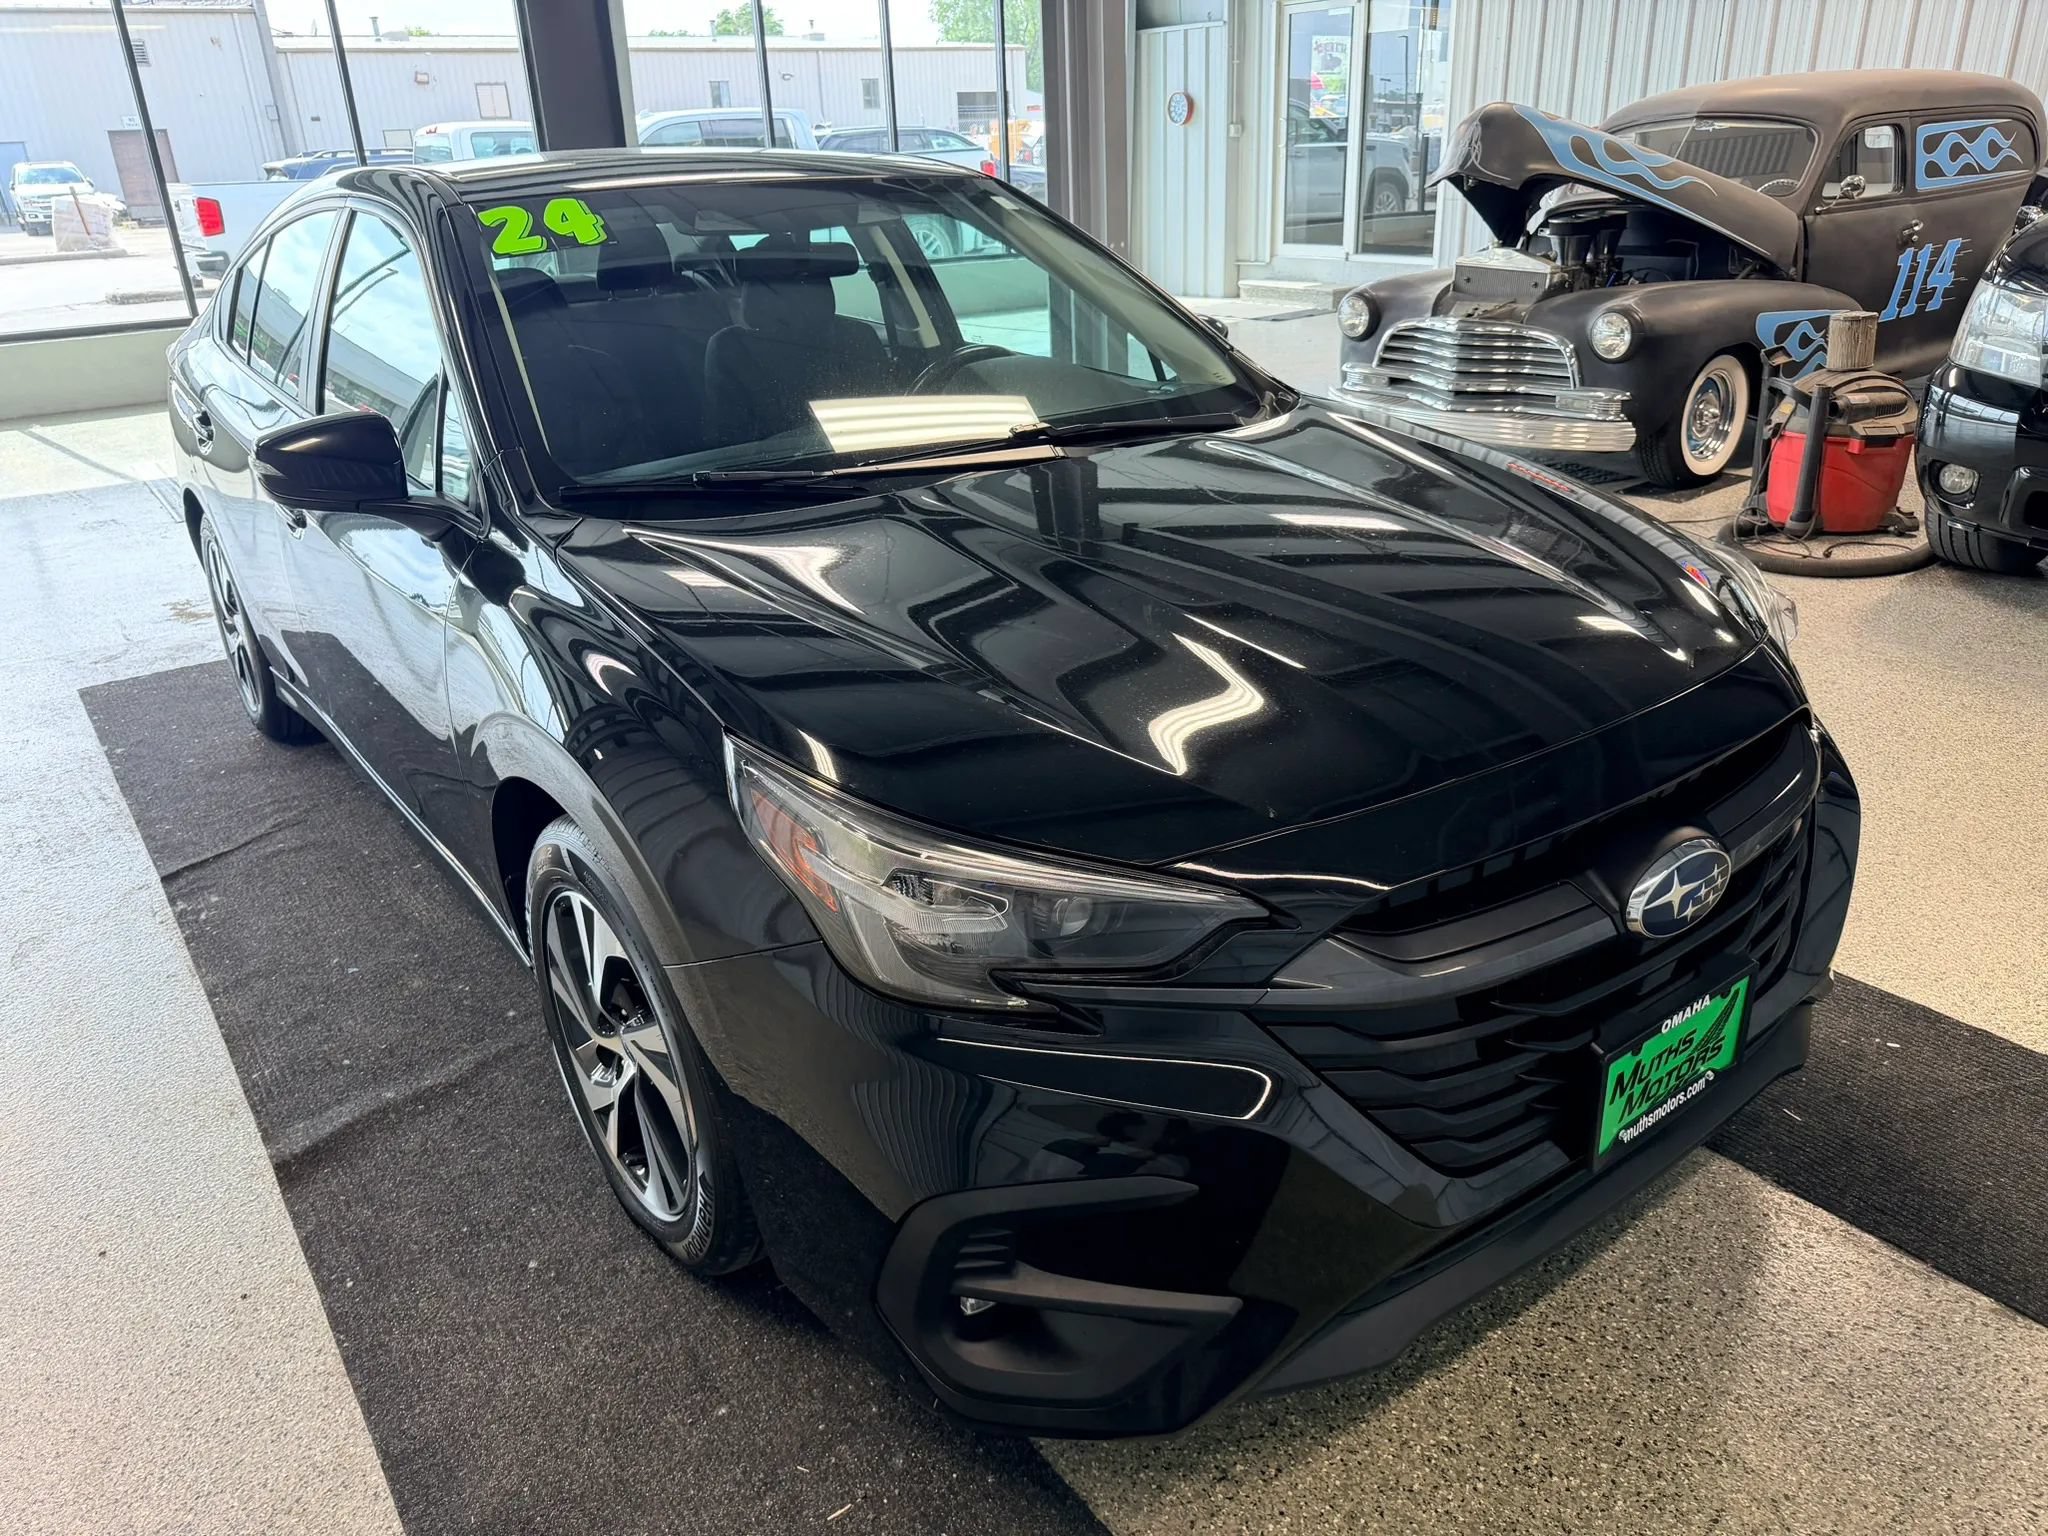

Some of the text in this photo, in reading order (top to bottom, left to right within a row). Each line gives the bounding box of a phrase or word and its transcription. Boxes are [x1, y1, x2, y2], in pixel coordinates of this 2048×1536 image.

[478, 197, 608, 255] 24
[1878, 238, 1962, 323] 114
[1661, 994, 1711, 1034] OMAHA
[1618, 1034, 1726, 1124] MOTORS
[1624, 1078, 1706, 1143] muthsmotors.com
